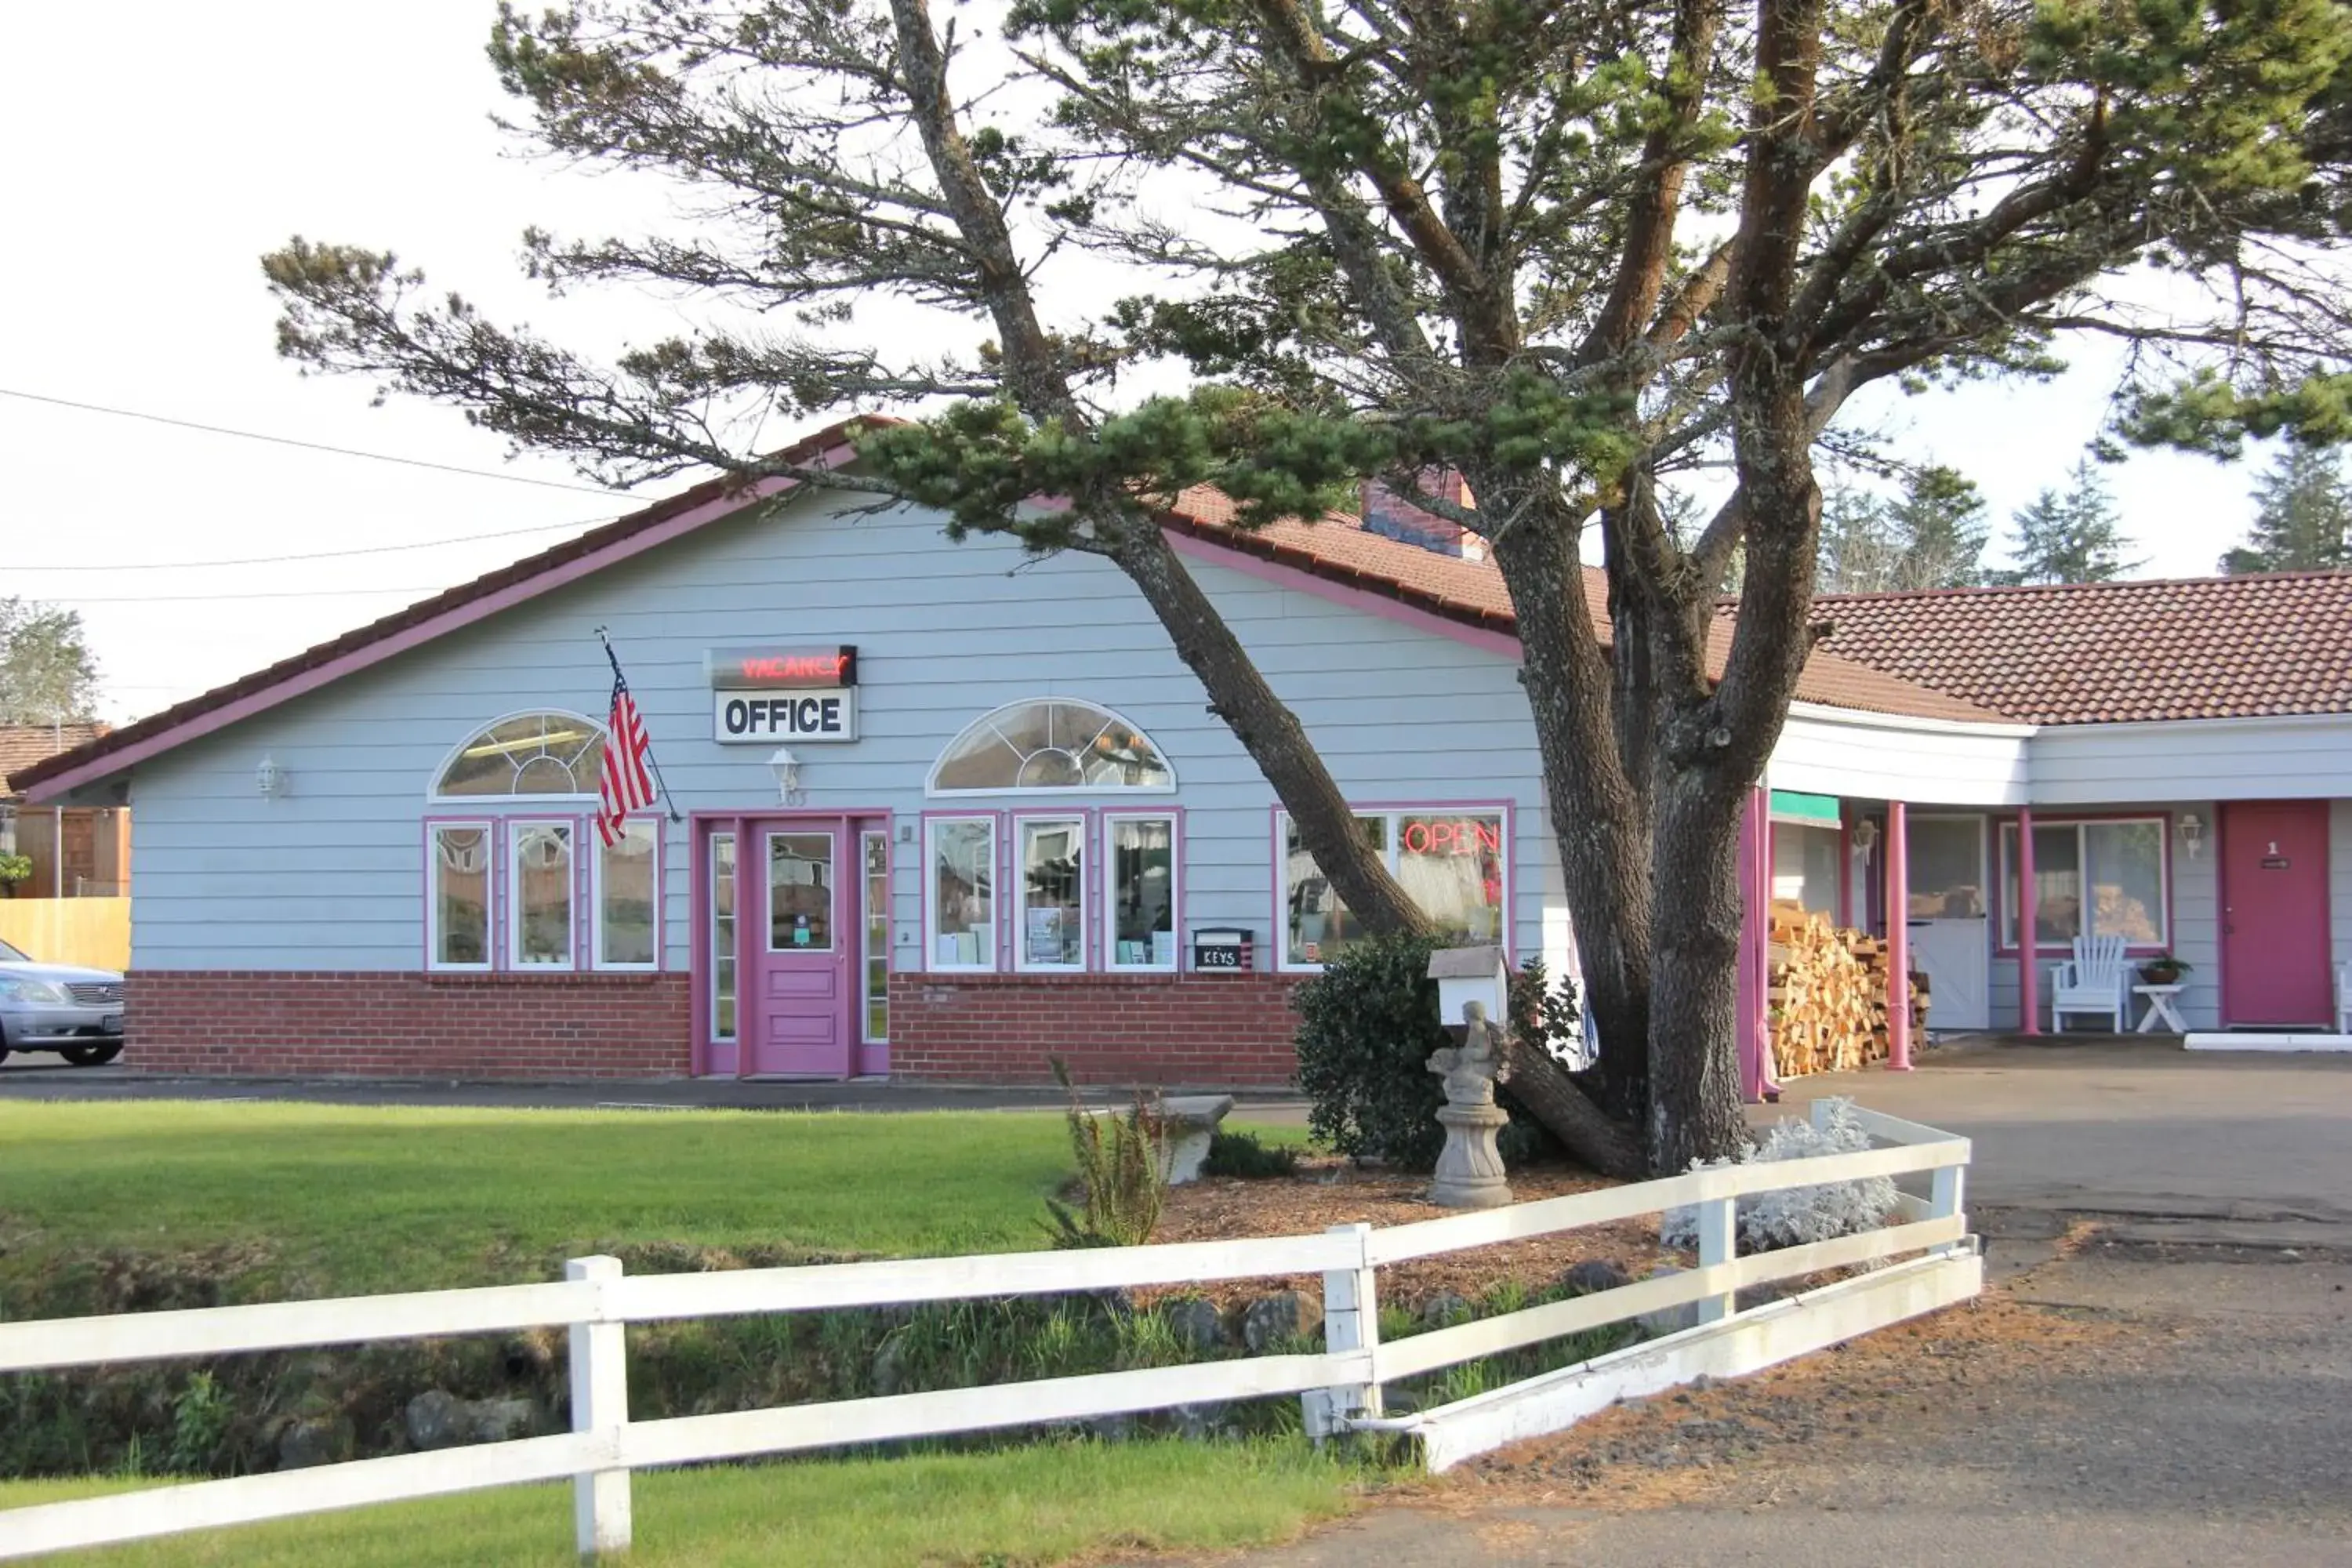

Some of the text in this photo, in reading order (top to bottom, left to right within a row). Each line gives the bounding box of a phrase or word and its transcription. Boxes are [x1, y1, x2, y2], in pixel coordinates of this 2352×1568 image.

[742, 655, 849, 678] VACANCY
[725, 697, 841, 734] OFFICE
[1404, 822, 1500, 854] OPEN
[1203, 951, 1236, 965] KEYS
